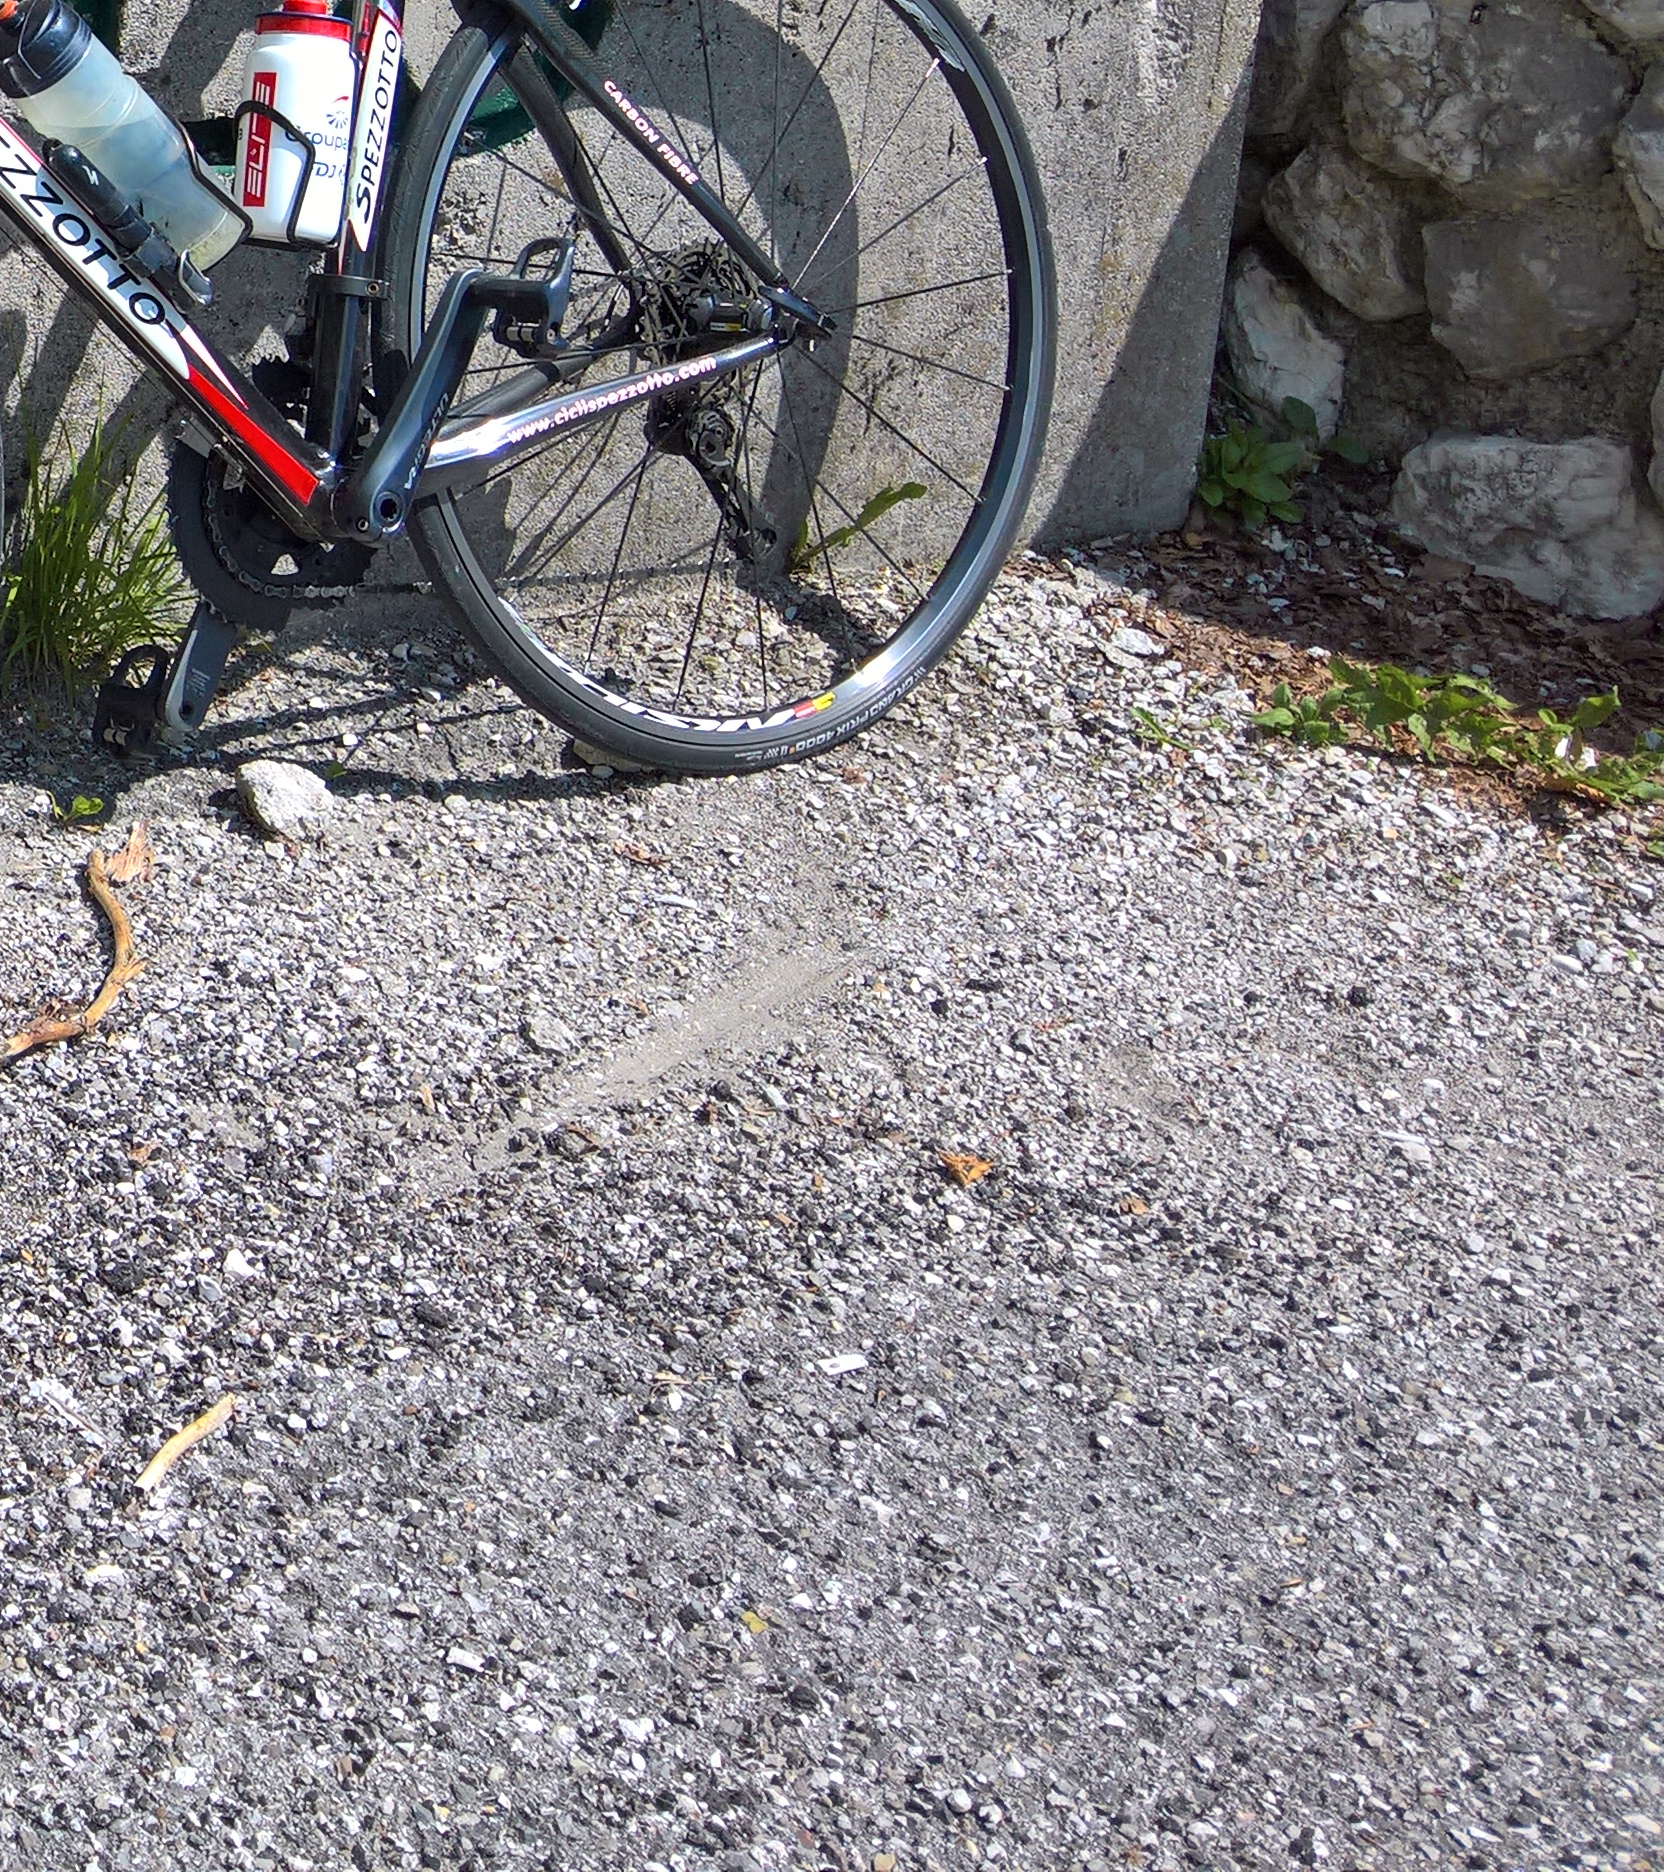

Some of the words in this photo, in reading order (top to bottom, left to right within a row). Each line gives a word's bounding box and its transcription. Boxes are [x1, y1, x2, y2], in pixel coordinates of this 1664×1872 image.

[356, 29, 398, 224] SPEZZOTTO
[603, 80, 659, 144] CARBON
[657, 143, 699, 185] FIBRE
